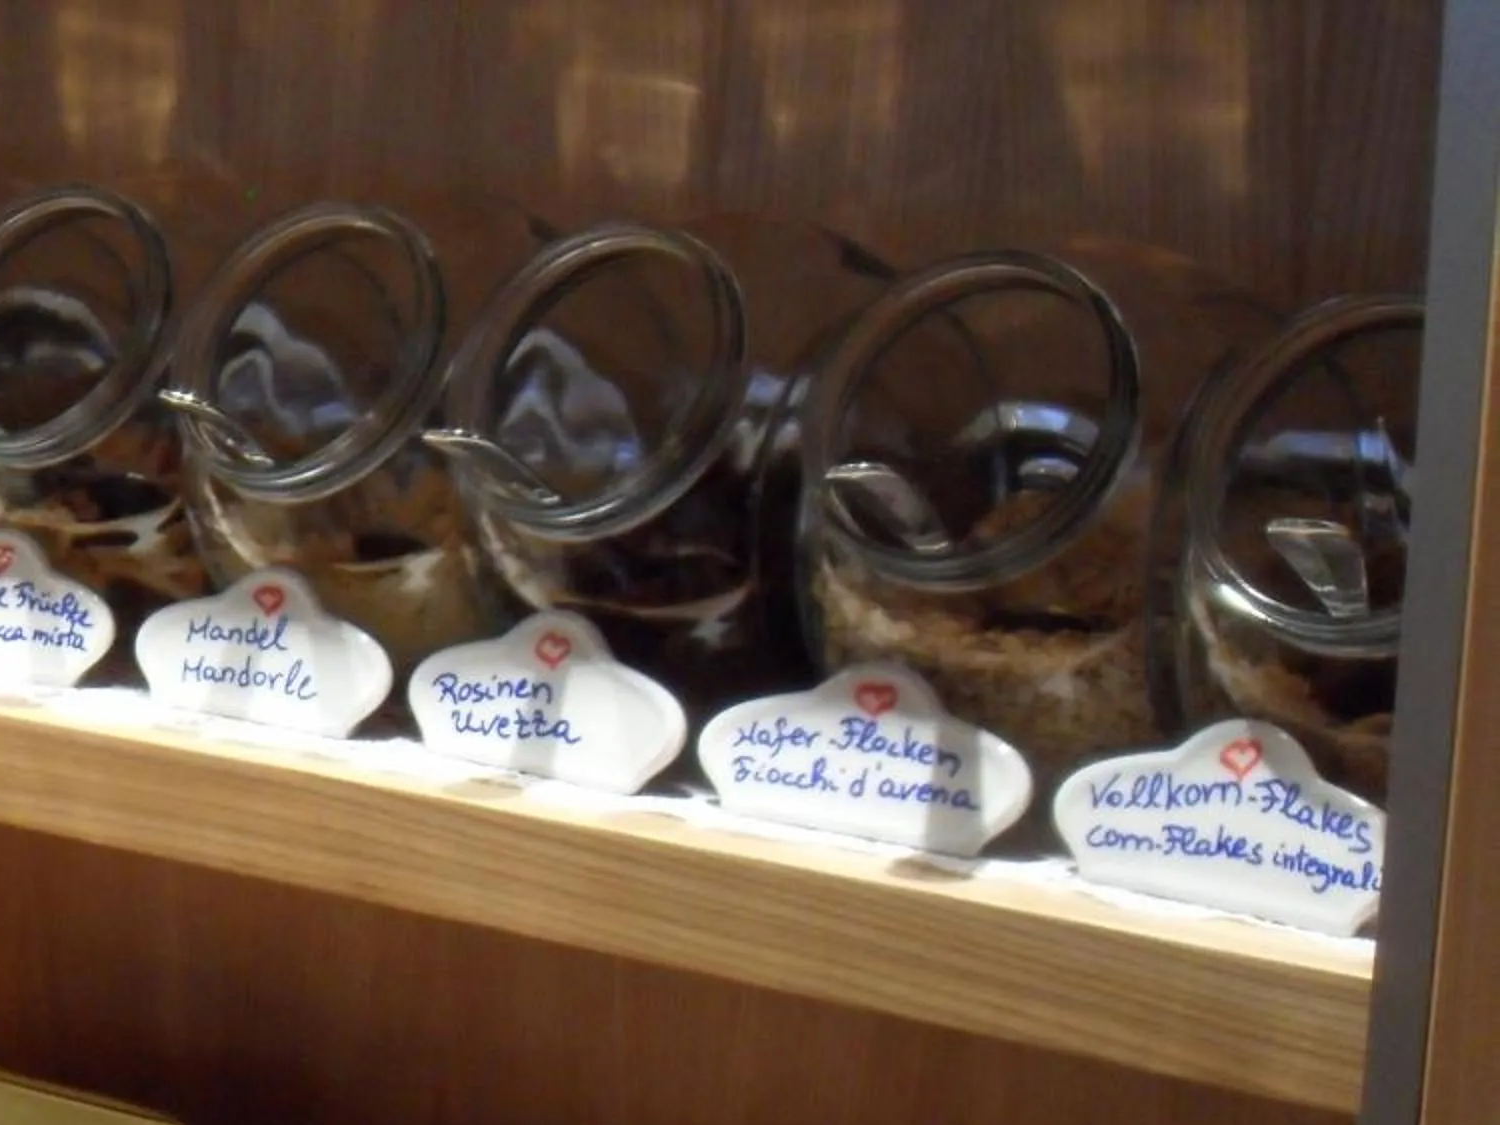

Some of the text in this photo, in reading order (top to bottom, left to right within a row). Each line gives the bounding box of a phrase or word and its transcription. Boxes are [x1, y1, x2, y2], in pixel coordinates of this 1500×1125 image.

[32, 621, 88, 651] mista
[186, 613, 289, 652] Mandel
[181, 654, 318, 700] Mandorle
[431, 671, 555, 705] Rosinen
